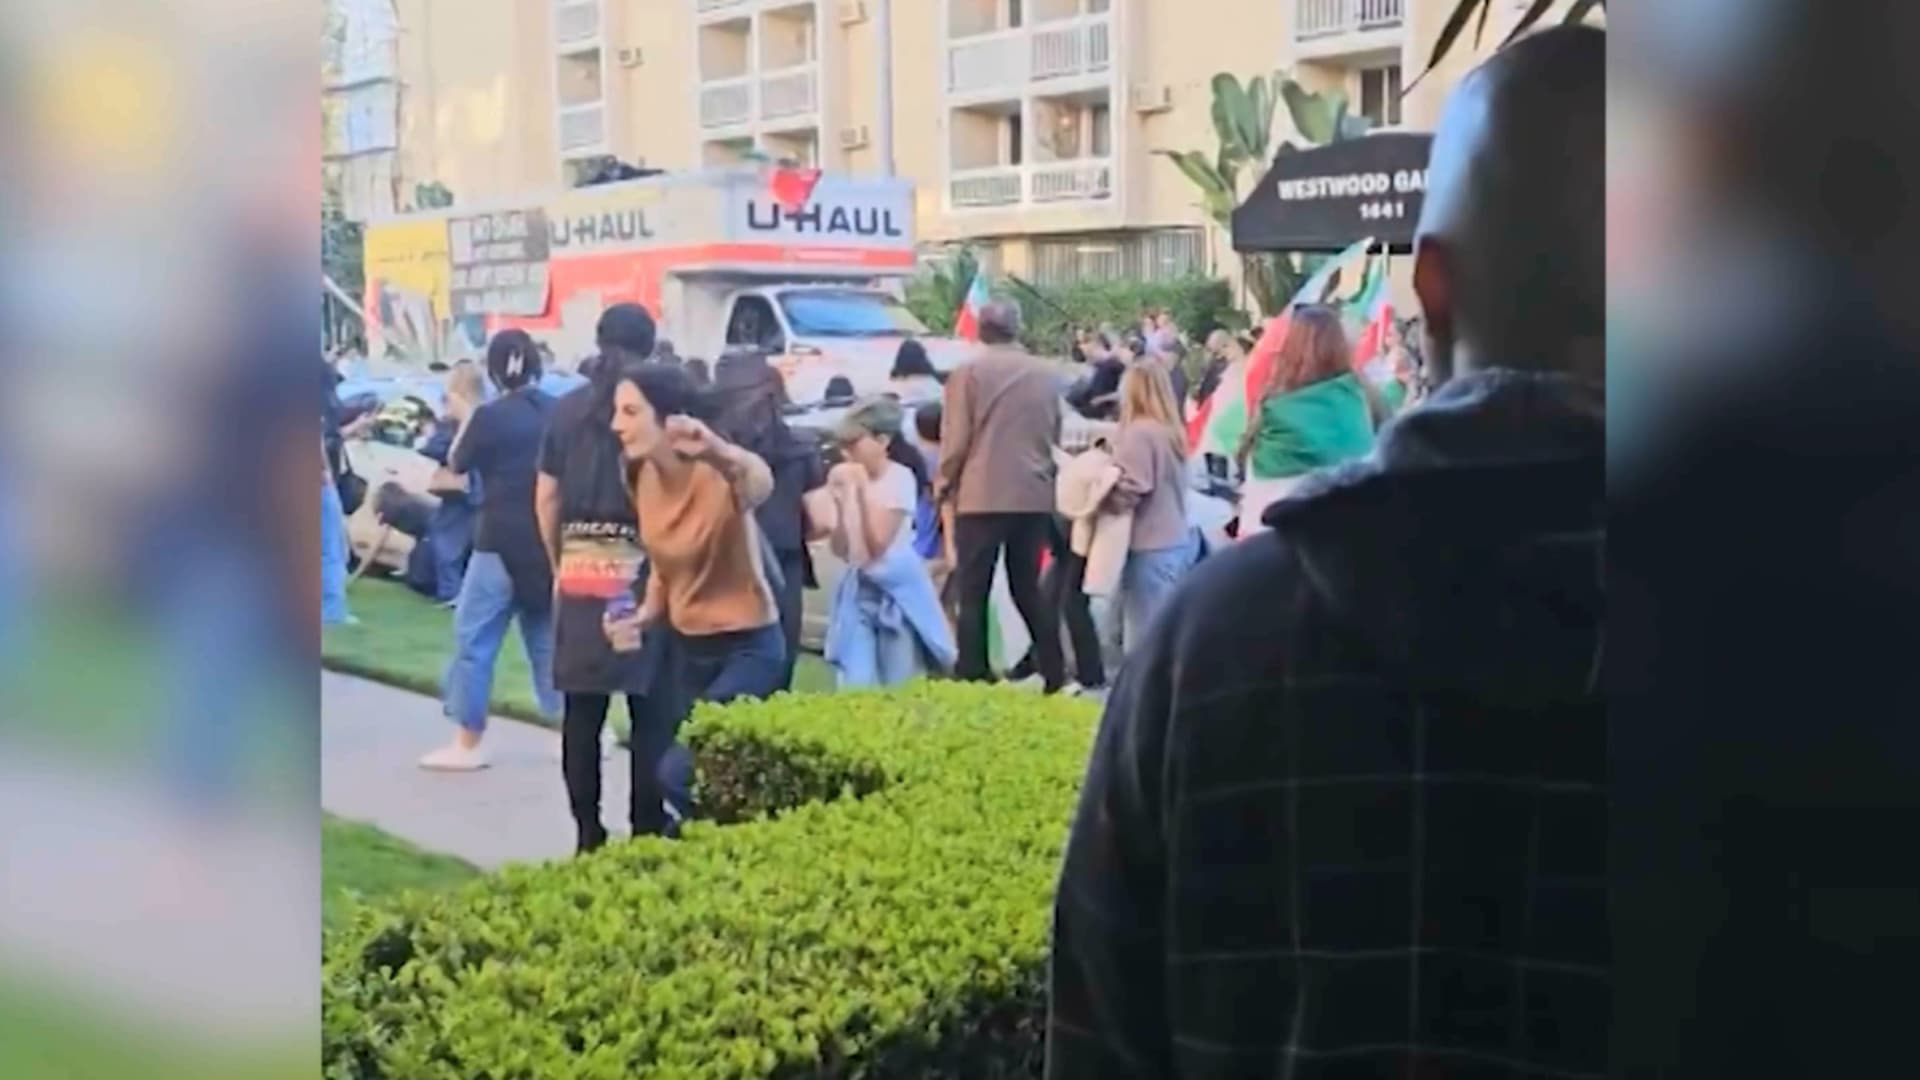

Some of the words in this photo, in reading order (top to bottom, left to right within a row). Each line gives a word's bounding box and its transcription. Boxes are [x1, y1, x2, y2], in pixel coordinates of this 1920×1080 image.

[1277, 172, 1390, 200] WESTWOOD
[549, 208, 655, 248] U-HAUL
[748, 199, 903, 237] U-HAUL
